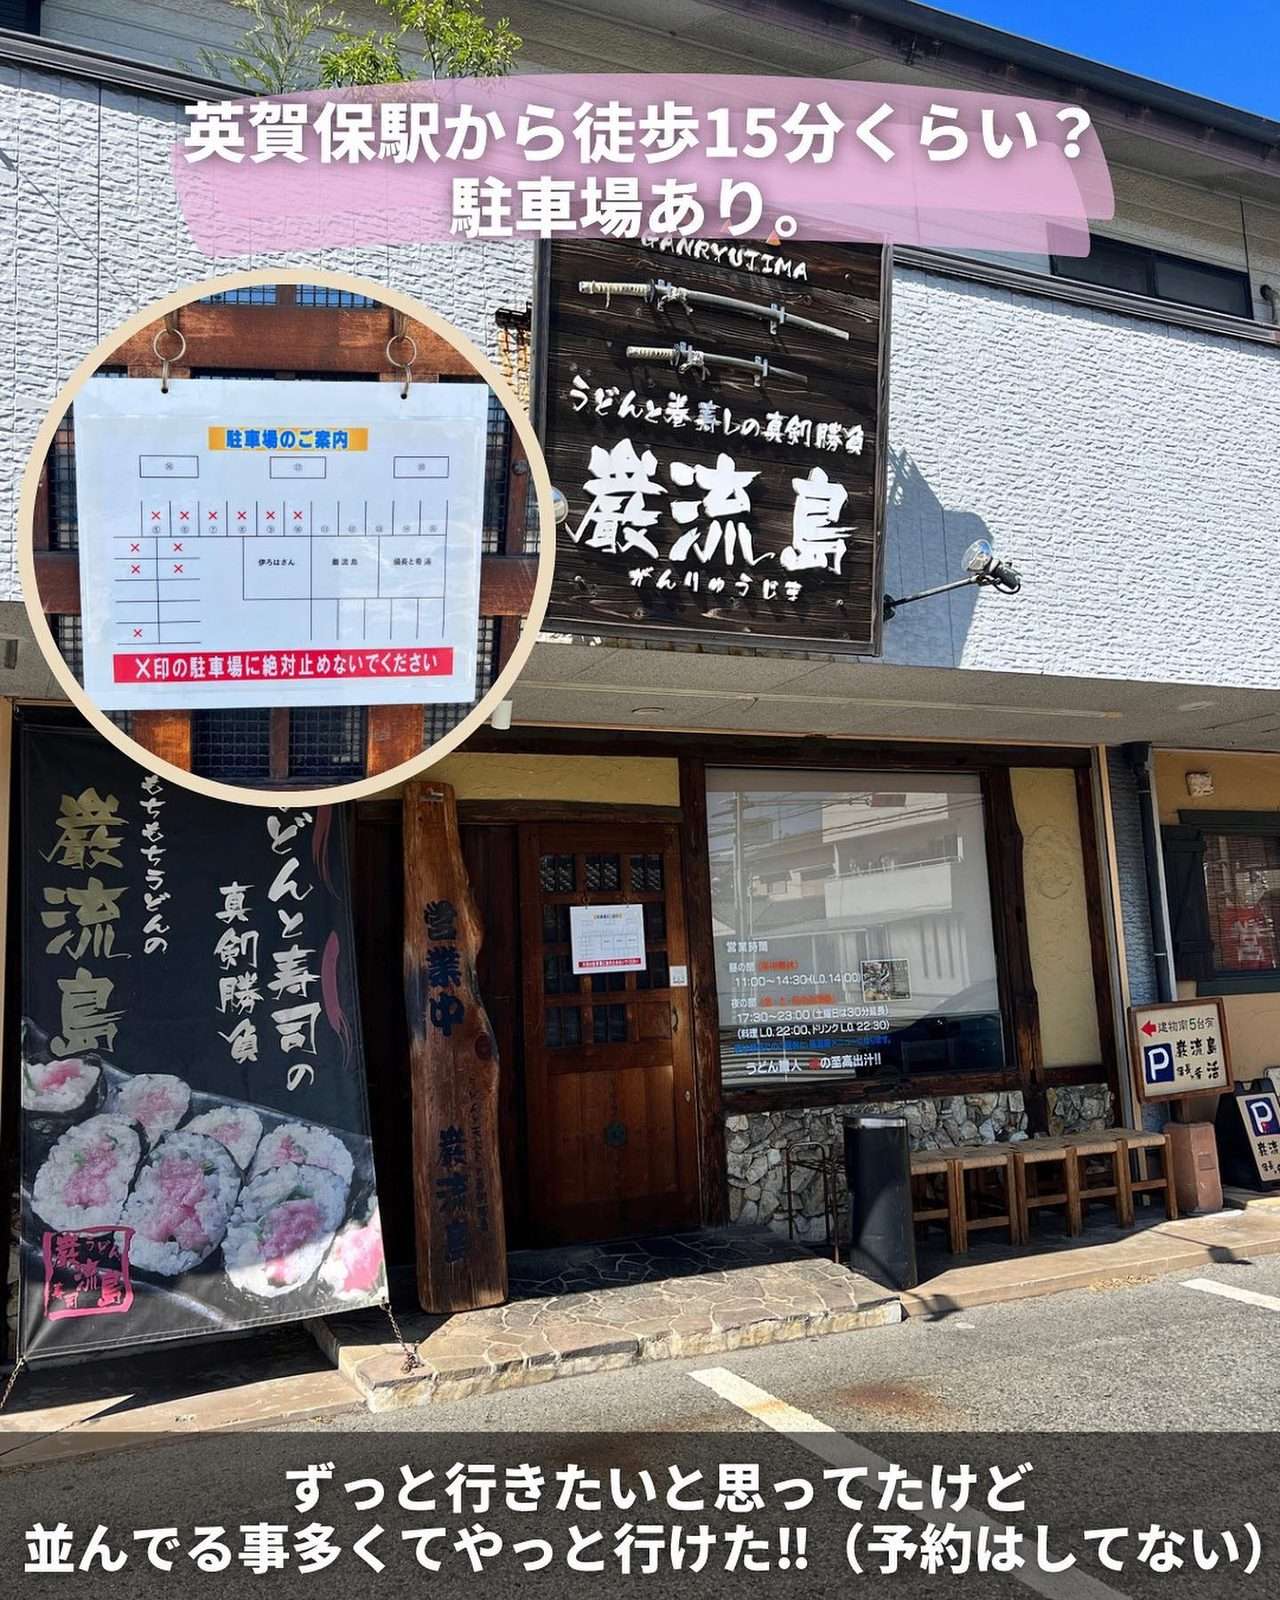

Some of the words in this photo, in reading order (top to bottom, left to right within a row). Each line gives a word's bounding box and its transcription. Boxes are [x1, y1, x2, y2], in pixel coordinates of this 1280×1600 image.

[226, 430, 348, 449] 駐車場のご案内
[628, 567, 803, 601] がんりゅうじま
[266, 806, 322, 1092] どんと寿司の
[214, 880, 265, 1064] 真剣勝負
[1147, 1046, 1170, 1081] P
